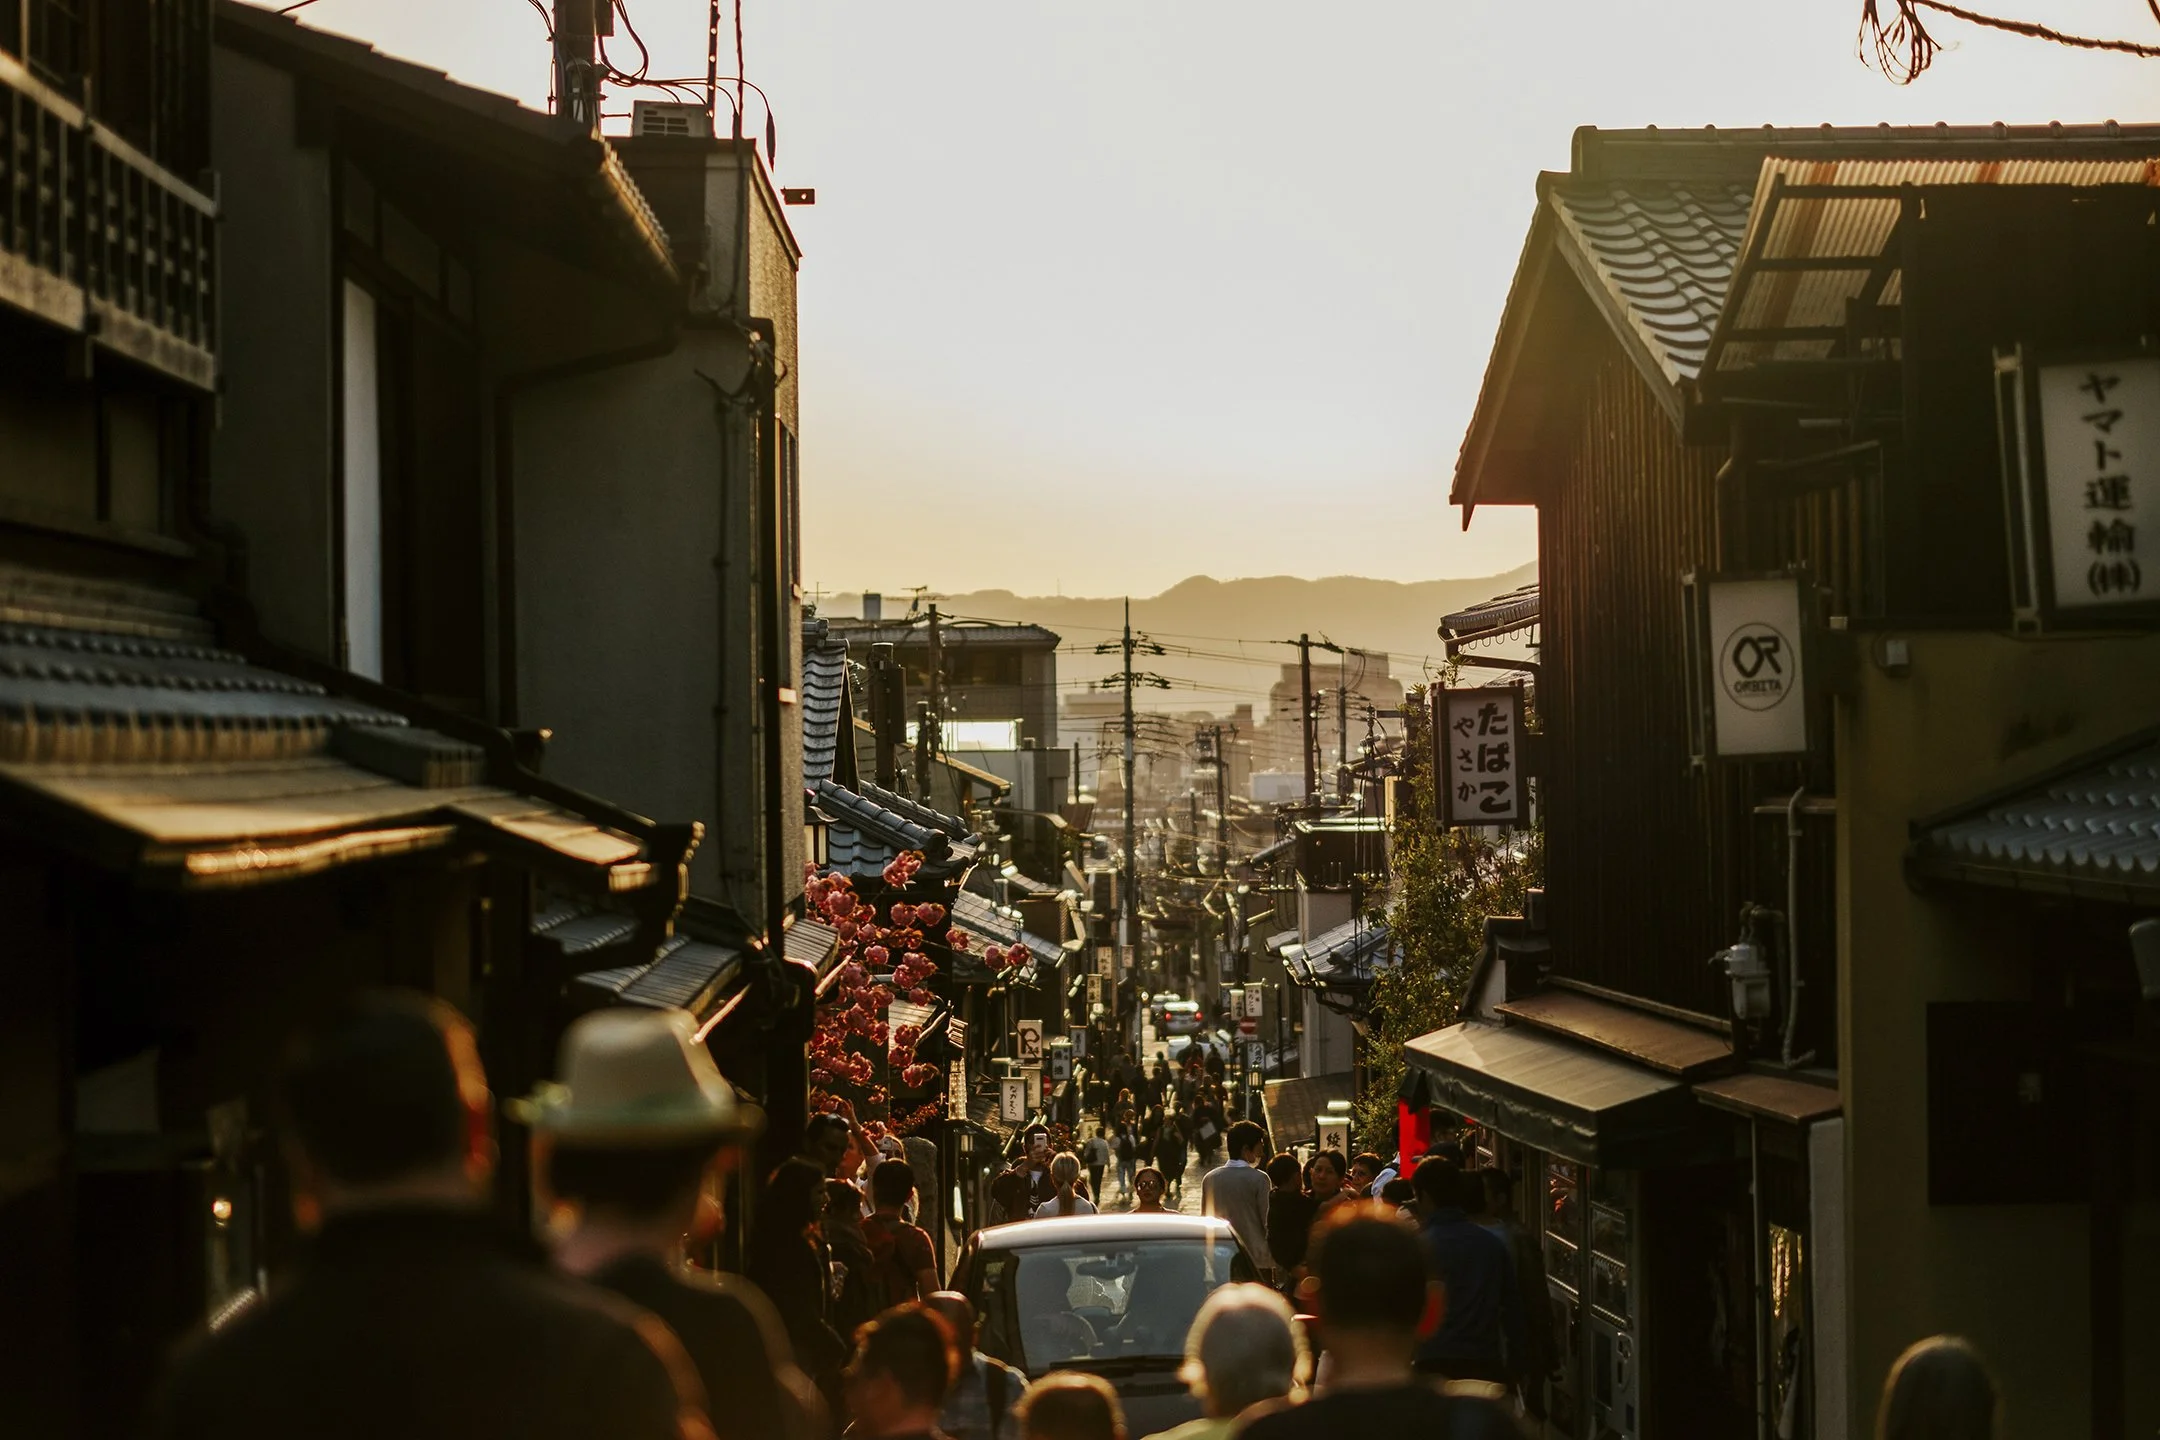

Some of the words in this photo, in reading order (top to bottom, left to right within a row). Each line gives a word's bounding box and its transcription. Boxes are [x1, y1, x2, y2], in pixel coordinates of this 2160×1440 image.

[1733, 635, 1782, 679] OR
[1453, 717, 1477, 802] やさか
[1477, 703, 1512, 814] たばこ
